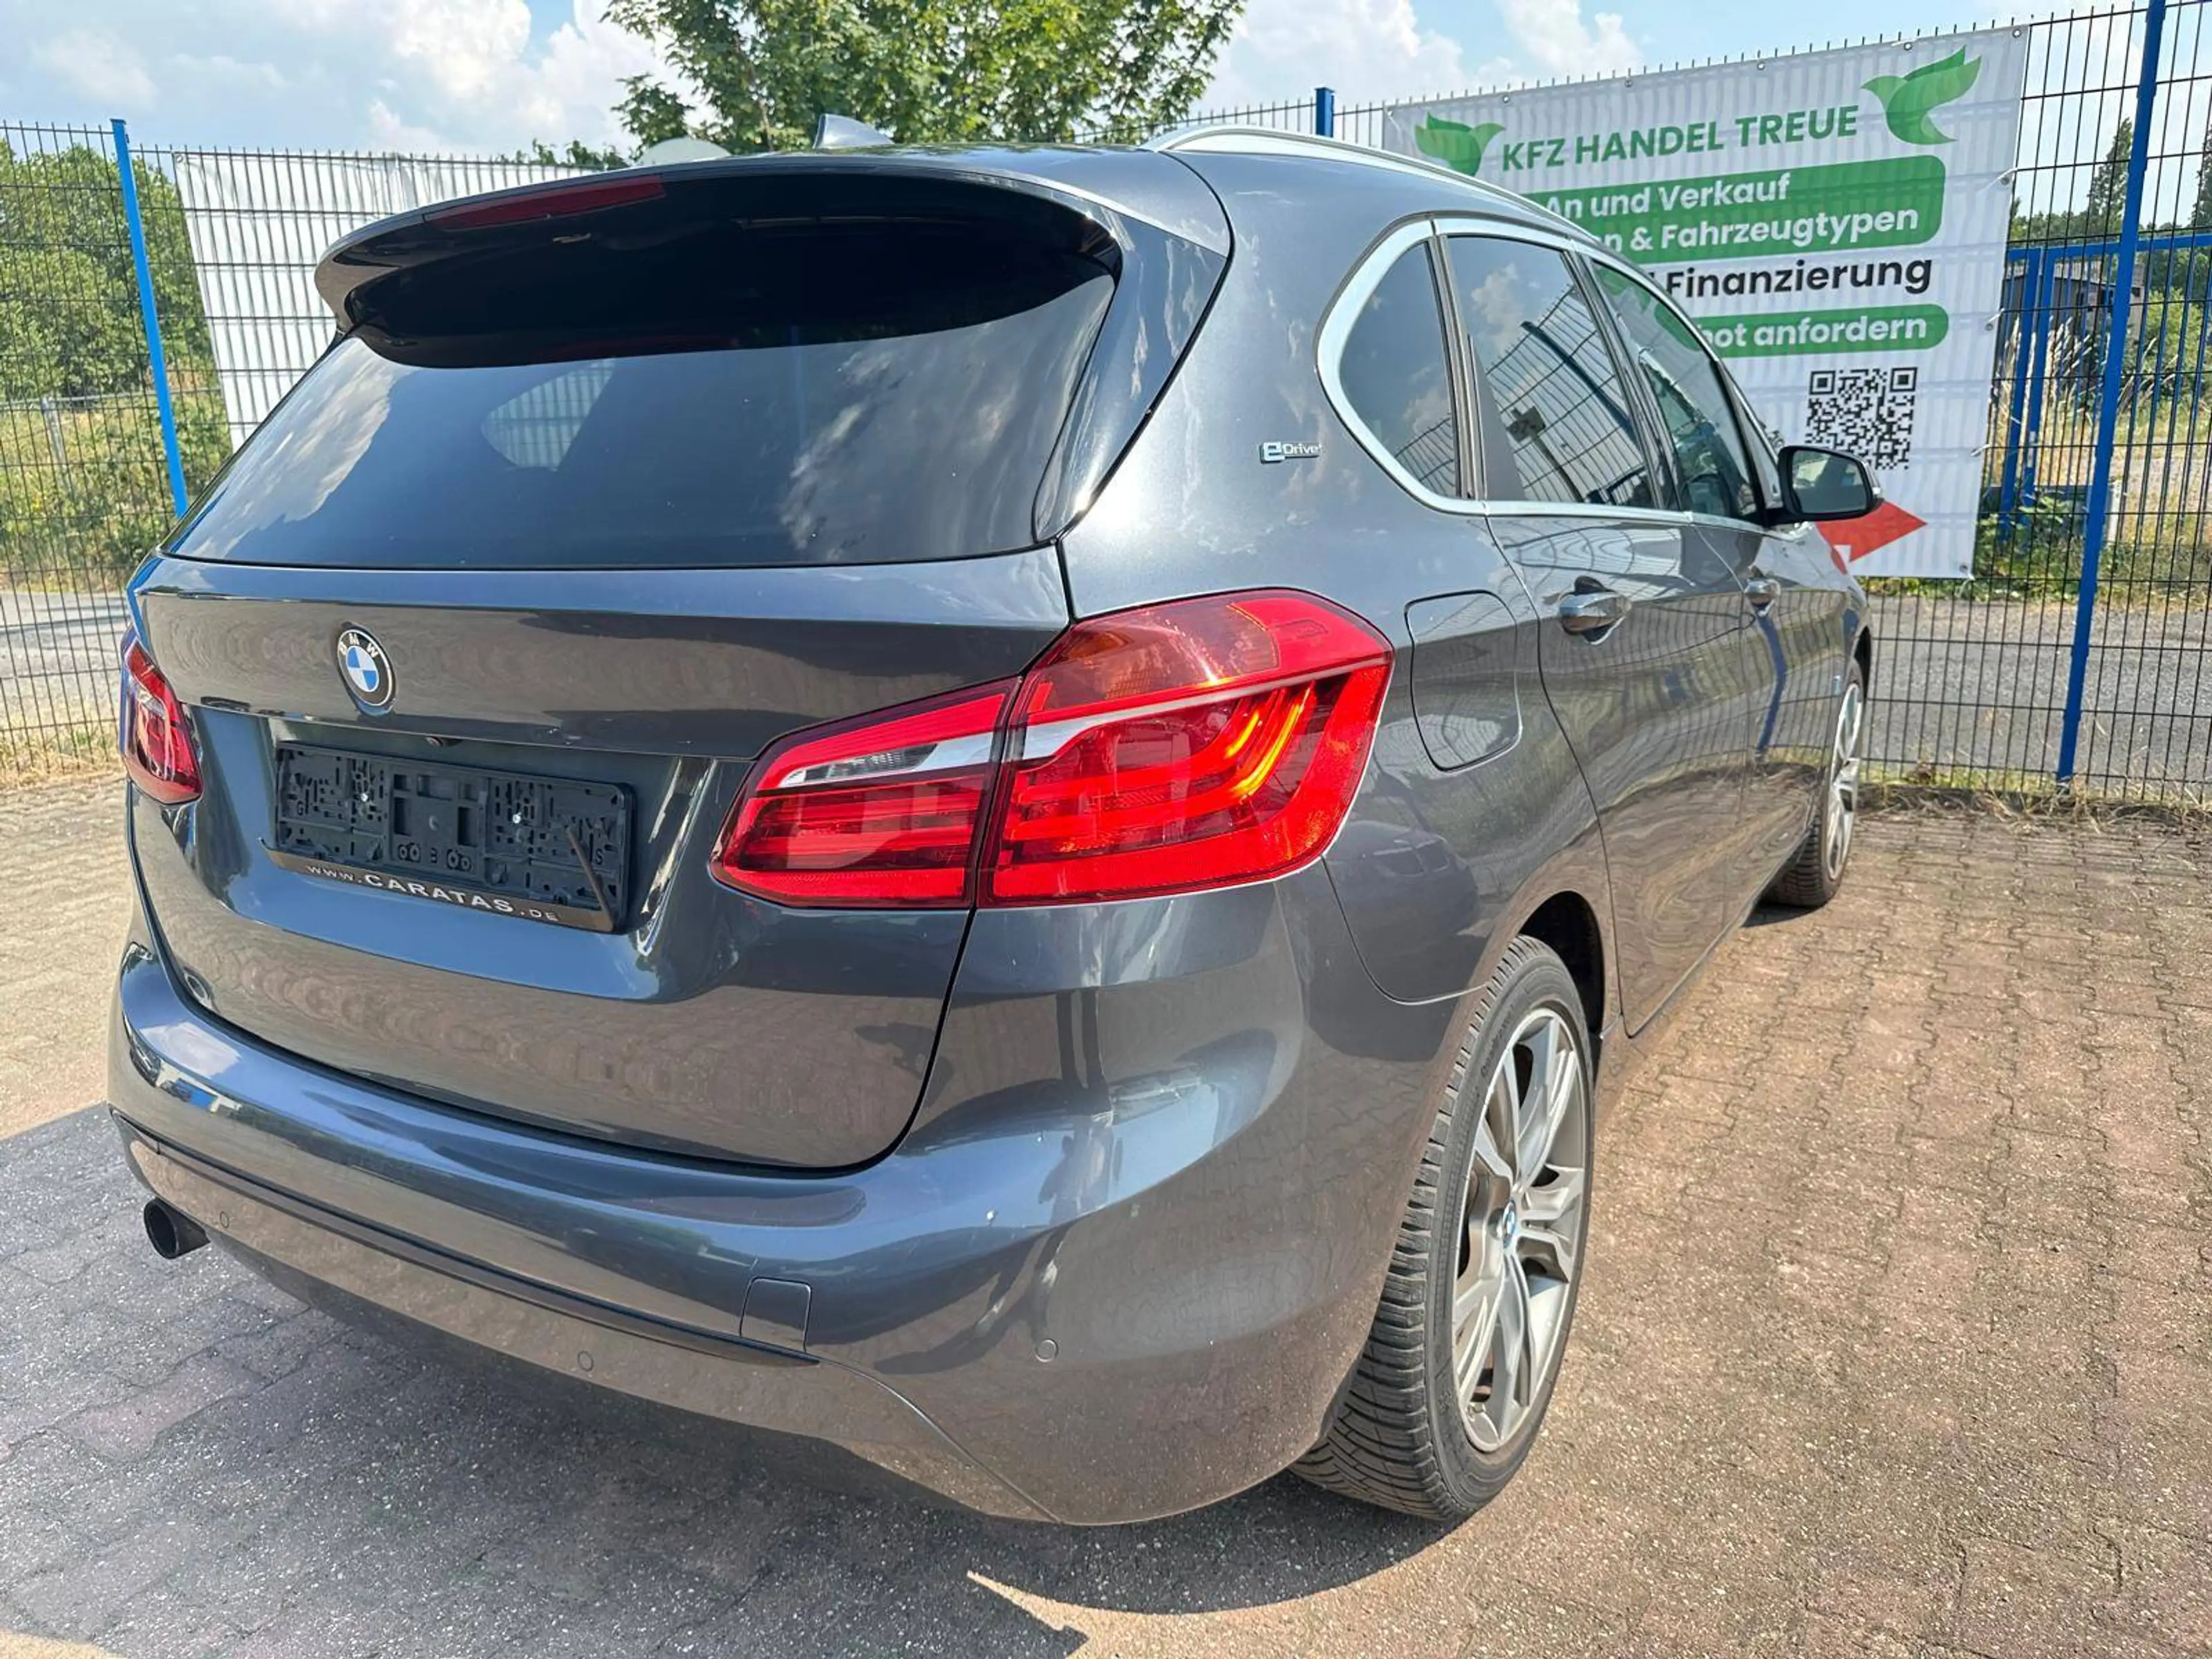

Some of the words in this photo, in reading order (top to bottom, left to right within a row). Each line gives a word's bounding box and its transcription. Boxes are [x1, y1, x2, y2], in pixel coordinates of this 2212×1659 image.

[1502, 138, 1566, 172] KFZ
[1574, 120, 1725, 164] HANDEL
[1735, 104, 1859, 147] TREUE
[1547, 196, 1583, 219] An
[1590, 187, 1651, 217] und
[1657, 172, 1791, 210] Verkauf
[1630, 226, 1654, 251] &
[1660, 208, 1919, 248] Fahrzeugtypen
[1666, 258, 1933, 298] Finanzierung
[1753, 316, 1927, 347] anfordern
